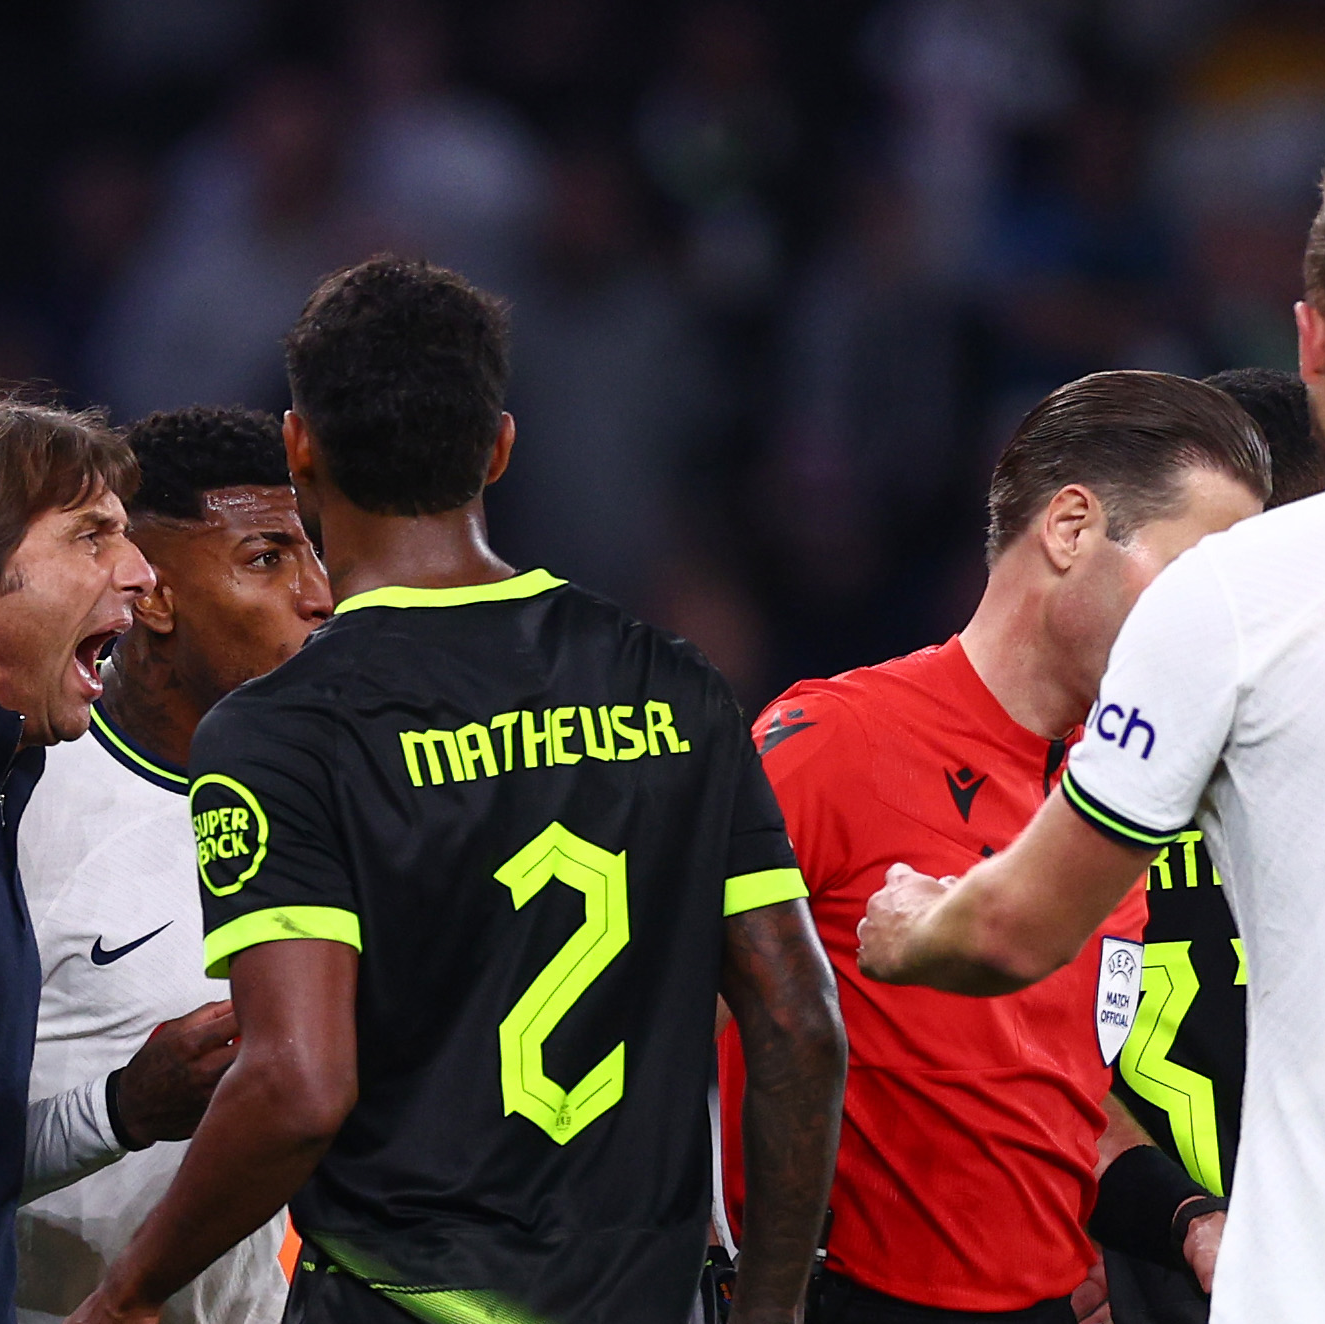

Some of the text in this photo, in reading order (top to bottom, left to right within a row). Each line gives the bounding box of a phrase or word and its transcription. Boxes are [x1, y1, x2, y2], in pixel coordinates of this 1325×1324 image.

[193, 806, 250, 842] SUPER
[197, 831, 251, 867] BOCK
[1107, 953, 1135, 979] UEFA
[493, 820, 631, 1146] 2
[1106, 990, 1131, 1009] MATCH
[1100, 1010, 1129, 1028] OFFICIAL
